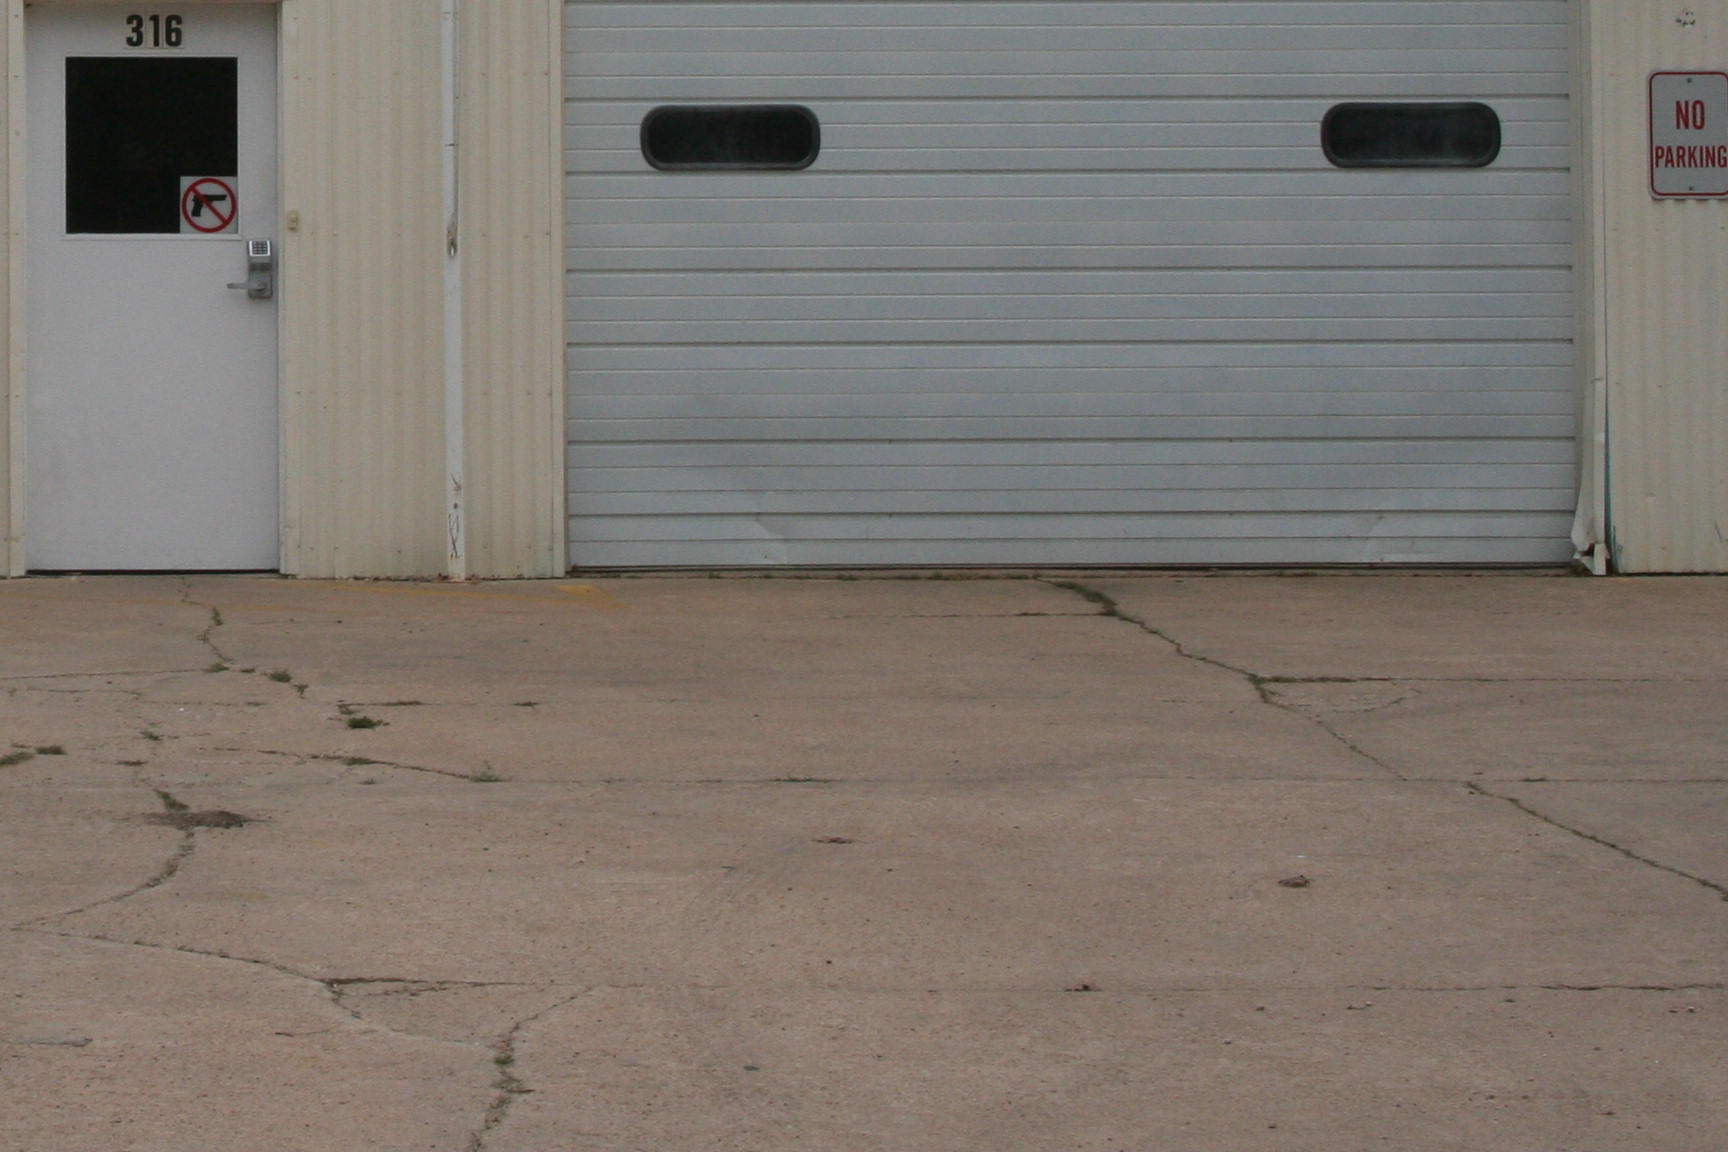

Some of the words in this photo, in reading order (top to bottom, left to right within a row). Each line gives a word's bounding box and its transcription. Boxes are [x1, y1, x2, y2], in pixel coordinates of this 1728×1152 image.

[125, 14, 183, 47] 316
[1675, 100, 1705, 130] NO
[1655, 145, 1728, 168] PARKING
